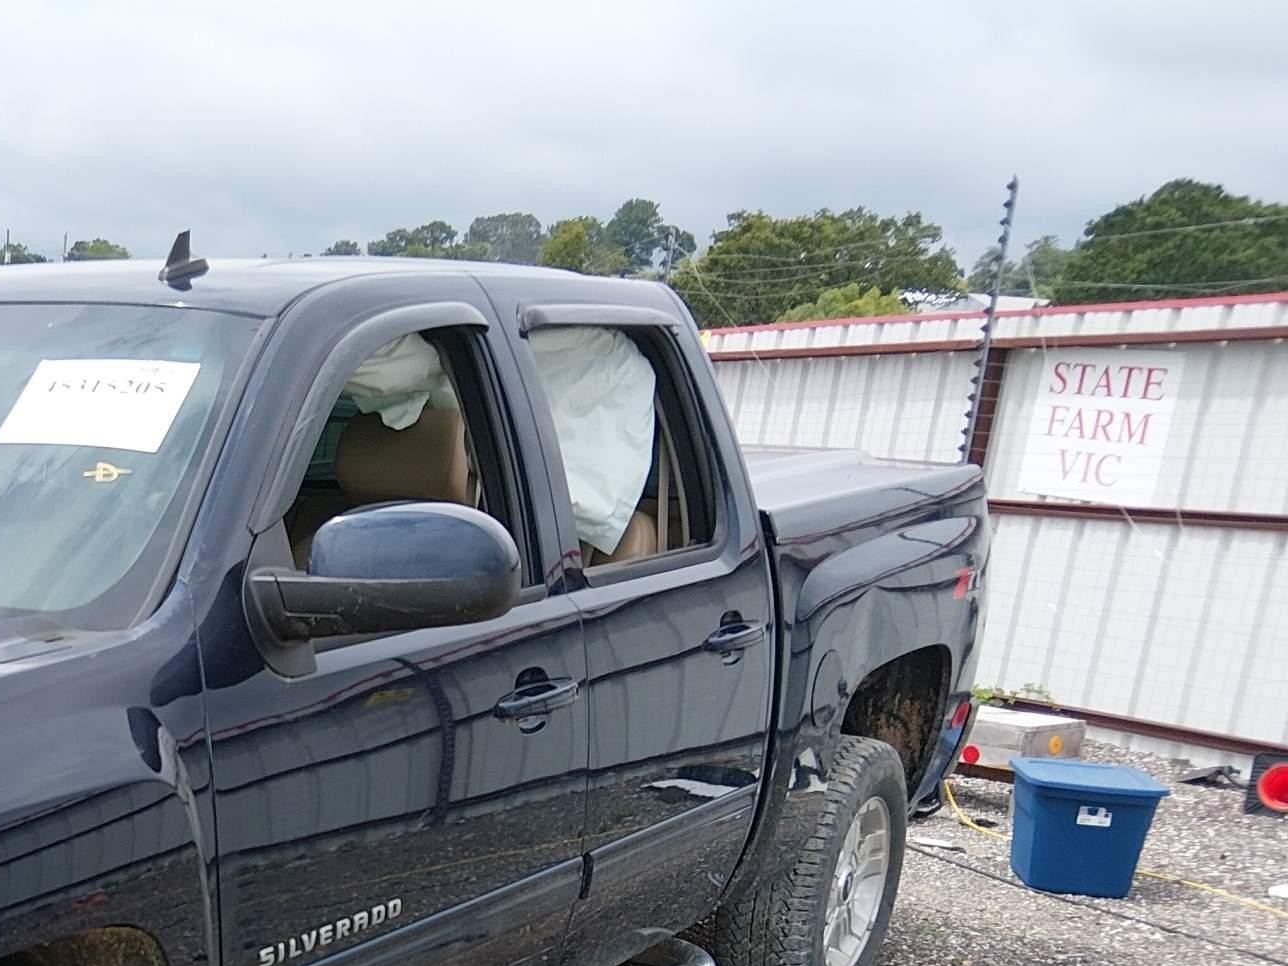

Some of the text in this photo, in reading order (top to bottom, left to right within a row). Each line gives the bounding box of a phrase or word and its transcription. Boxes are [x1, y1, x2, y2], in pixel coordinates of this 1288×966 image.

[1048, 361, 1169, 401] STATE
[1044, 405, 1155, 446] FARM
[1059, 448, 1122, 487] VIC
